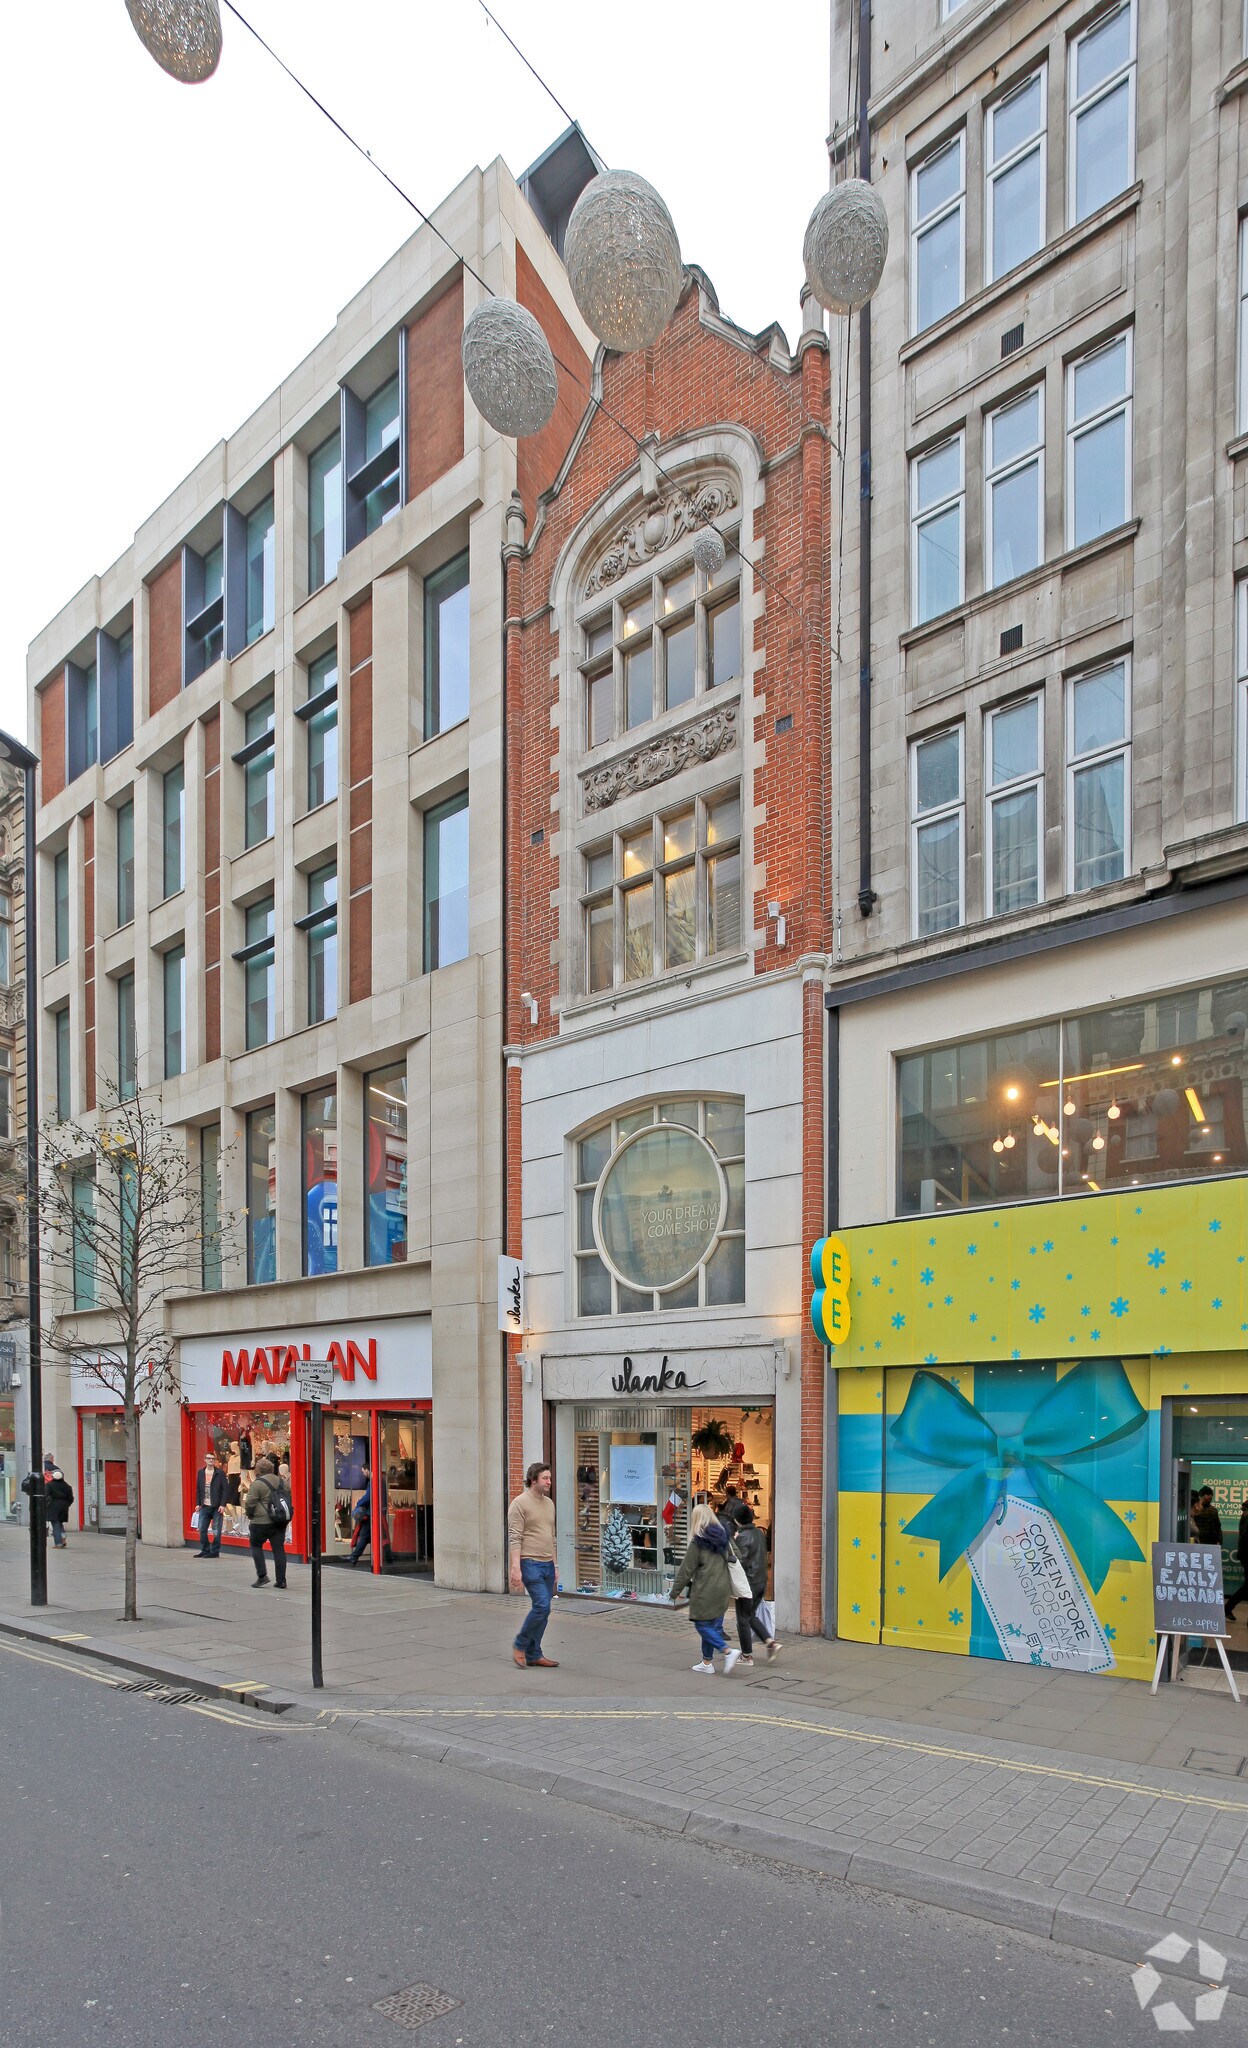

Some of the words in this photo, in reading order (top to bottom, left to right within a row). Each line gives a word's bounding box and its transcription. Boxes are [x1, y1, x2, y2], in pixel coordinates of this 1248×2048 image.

[641, 1209, 672, 1224] YOUR
[648, 1223, 680, 1238] COME
[507, 1266, 521, 1324] ulanka
[612, 1356, 707, 1393] ulanka
[312, 1384, 330, 1392] loading
[1165, 1551, 1215, 1571] FREE
[1030, 1524, 1057, 1569] COME
[1049, 1569, 1066, 1589] IN
[1059, 1590, 1090, 1641] STORE
[1160, 1568, 1218, 1588] EARLY
[1003, 1535, 1045, 1616] CHANGING
[1039, 1618, 1064, 1661] GIFTS
[1016, 1528, 1046, 1578] TODAY
[1038, 1580, 1060, 1613] FOR
[1053, 1615, 1080, 1659] GAME
[1156, 1585, 1223, 1605] UPGRADE
[1195, 1619, 1219, 1631] apply
